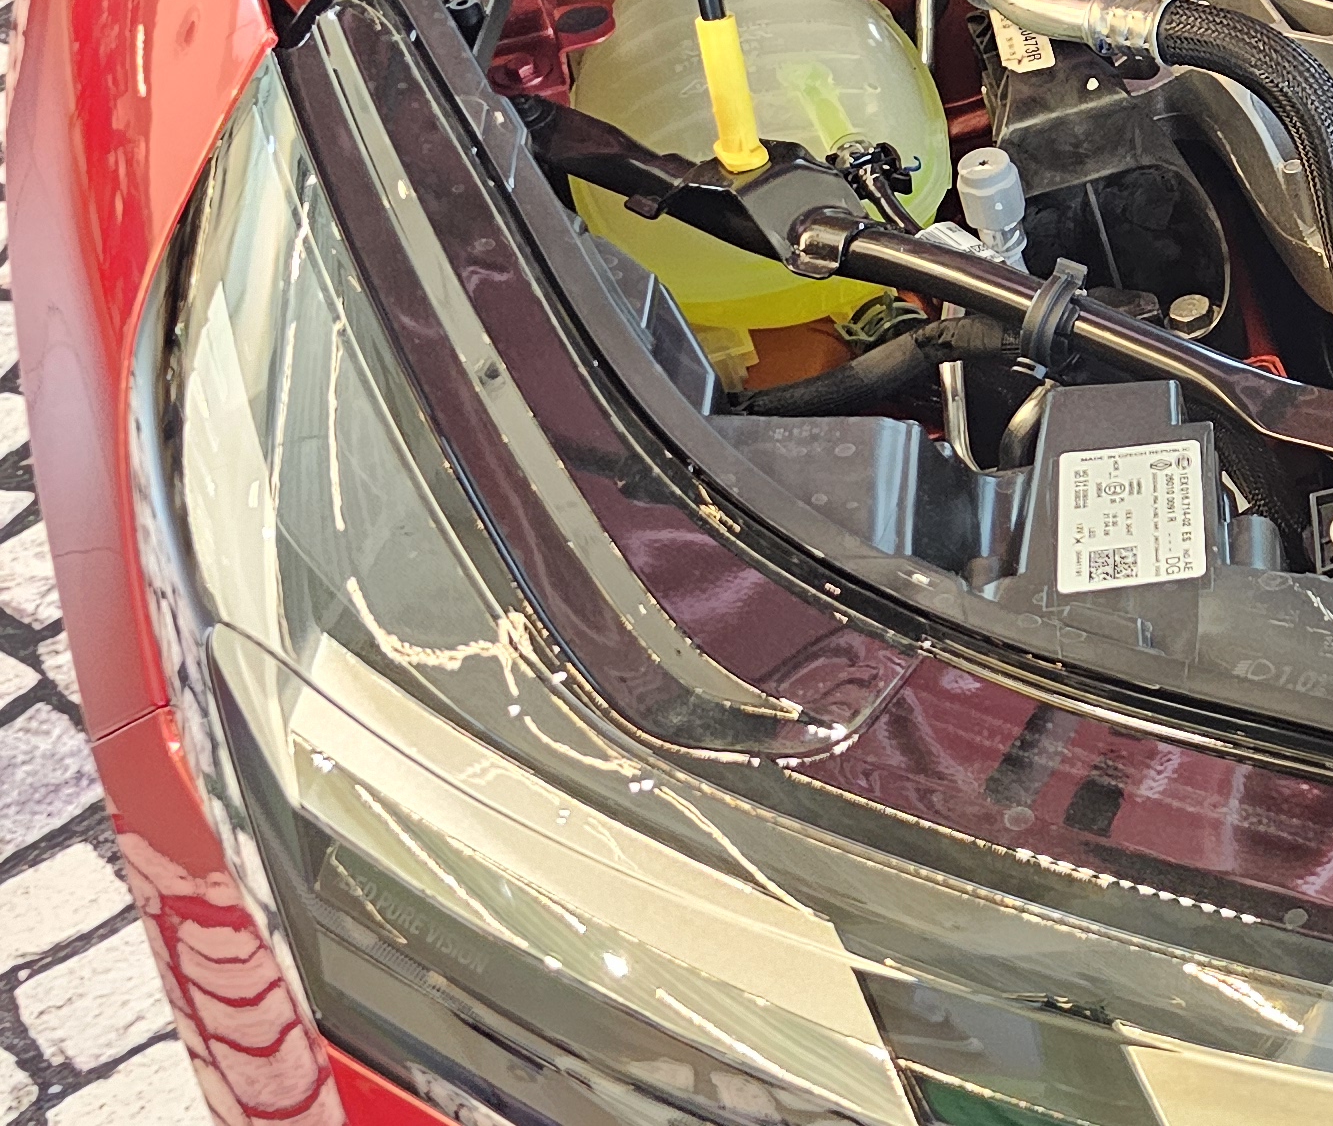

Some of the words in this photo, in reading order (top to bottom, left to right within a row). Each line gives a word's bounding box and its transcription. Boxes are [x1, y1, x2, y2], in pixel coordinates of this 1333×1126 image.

[1149, 447, 1190, 456] REPUBLIC
[1182, 531, 1192, 542] ES
[1166, 557, 1181, 575] DG
[1183, 561, 1194, 572] AE
[425, 922, 490, 974] VISION
